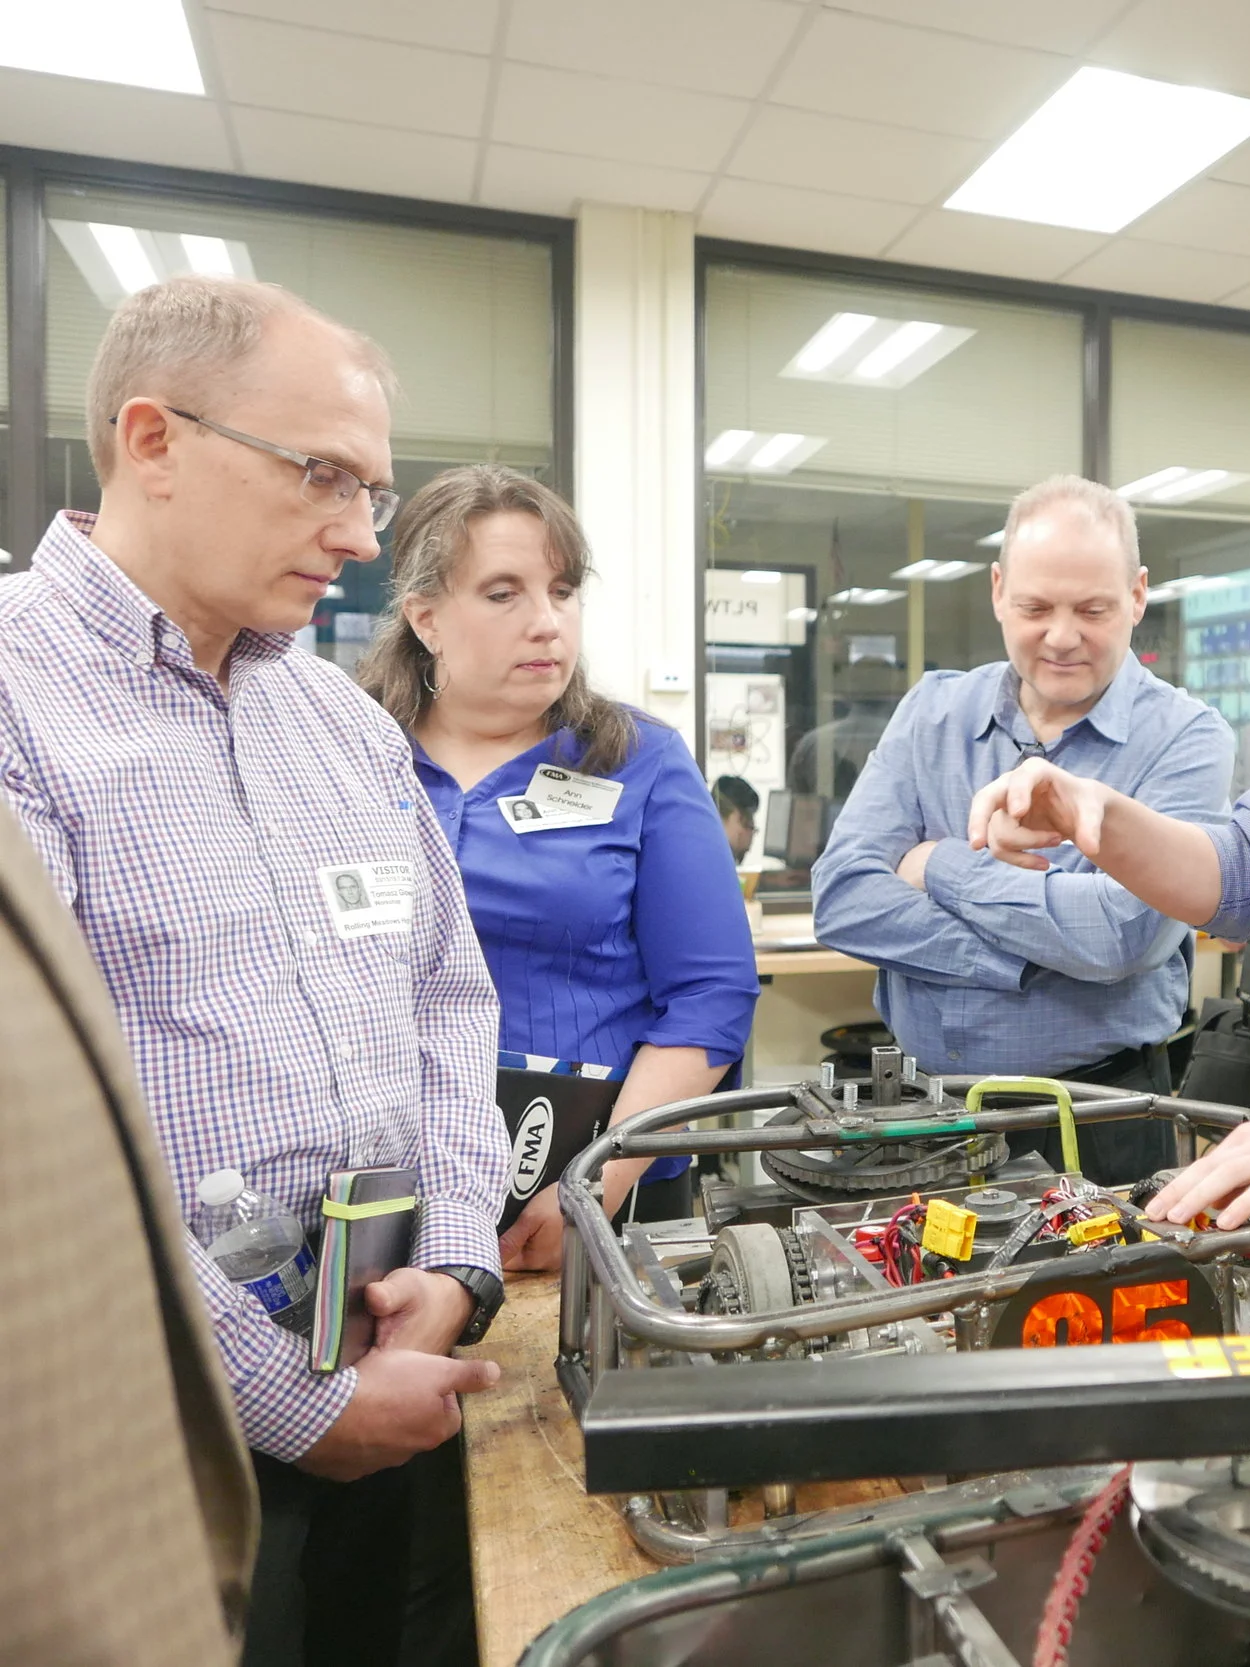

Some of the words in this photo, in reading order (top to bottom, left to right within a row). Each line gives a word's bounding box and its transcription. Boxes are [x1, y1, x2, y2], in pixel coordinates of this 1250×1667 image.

[563, 789, 582, 799] Ann
[546, 794, 593, 811] Schneider
[372, 866, 410, 875] VISITOR
[344, 923, 371, 931] Rolling
[517, 1122, 546, 1176] FMA
